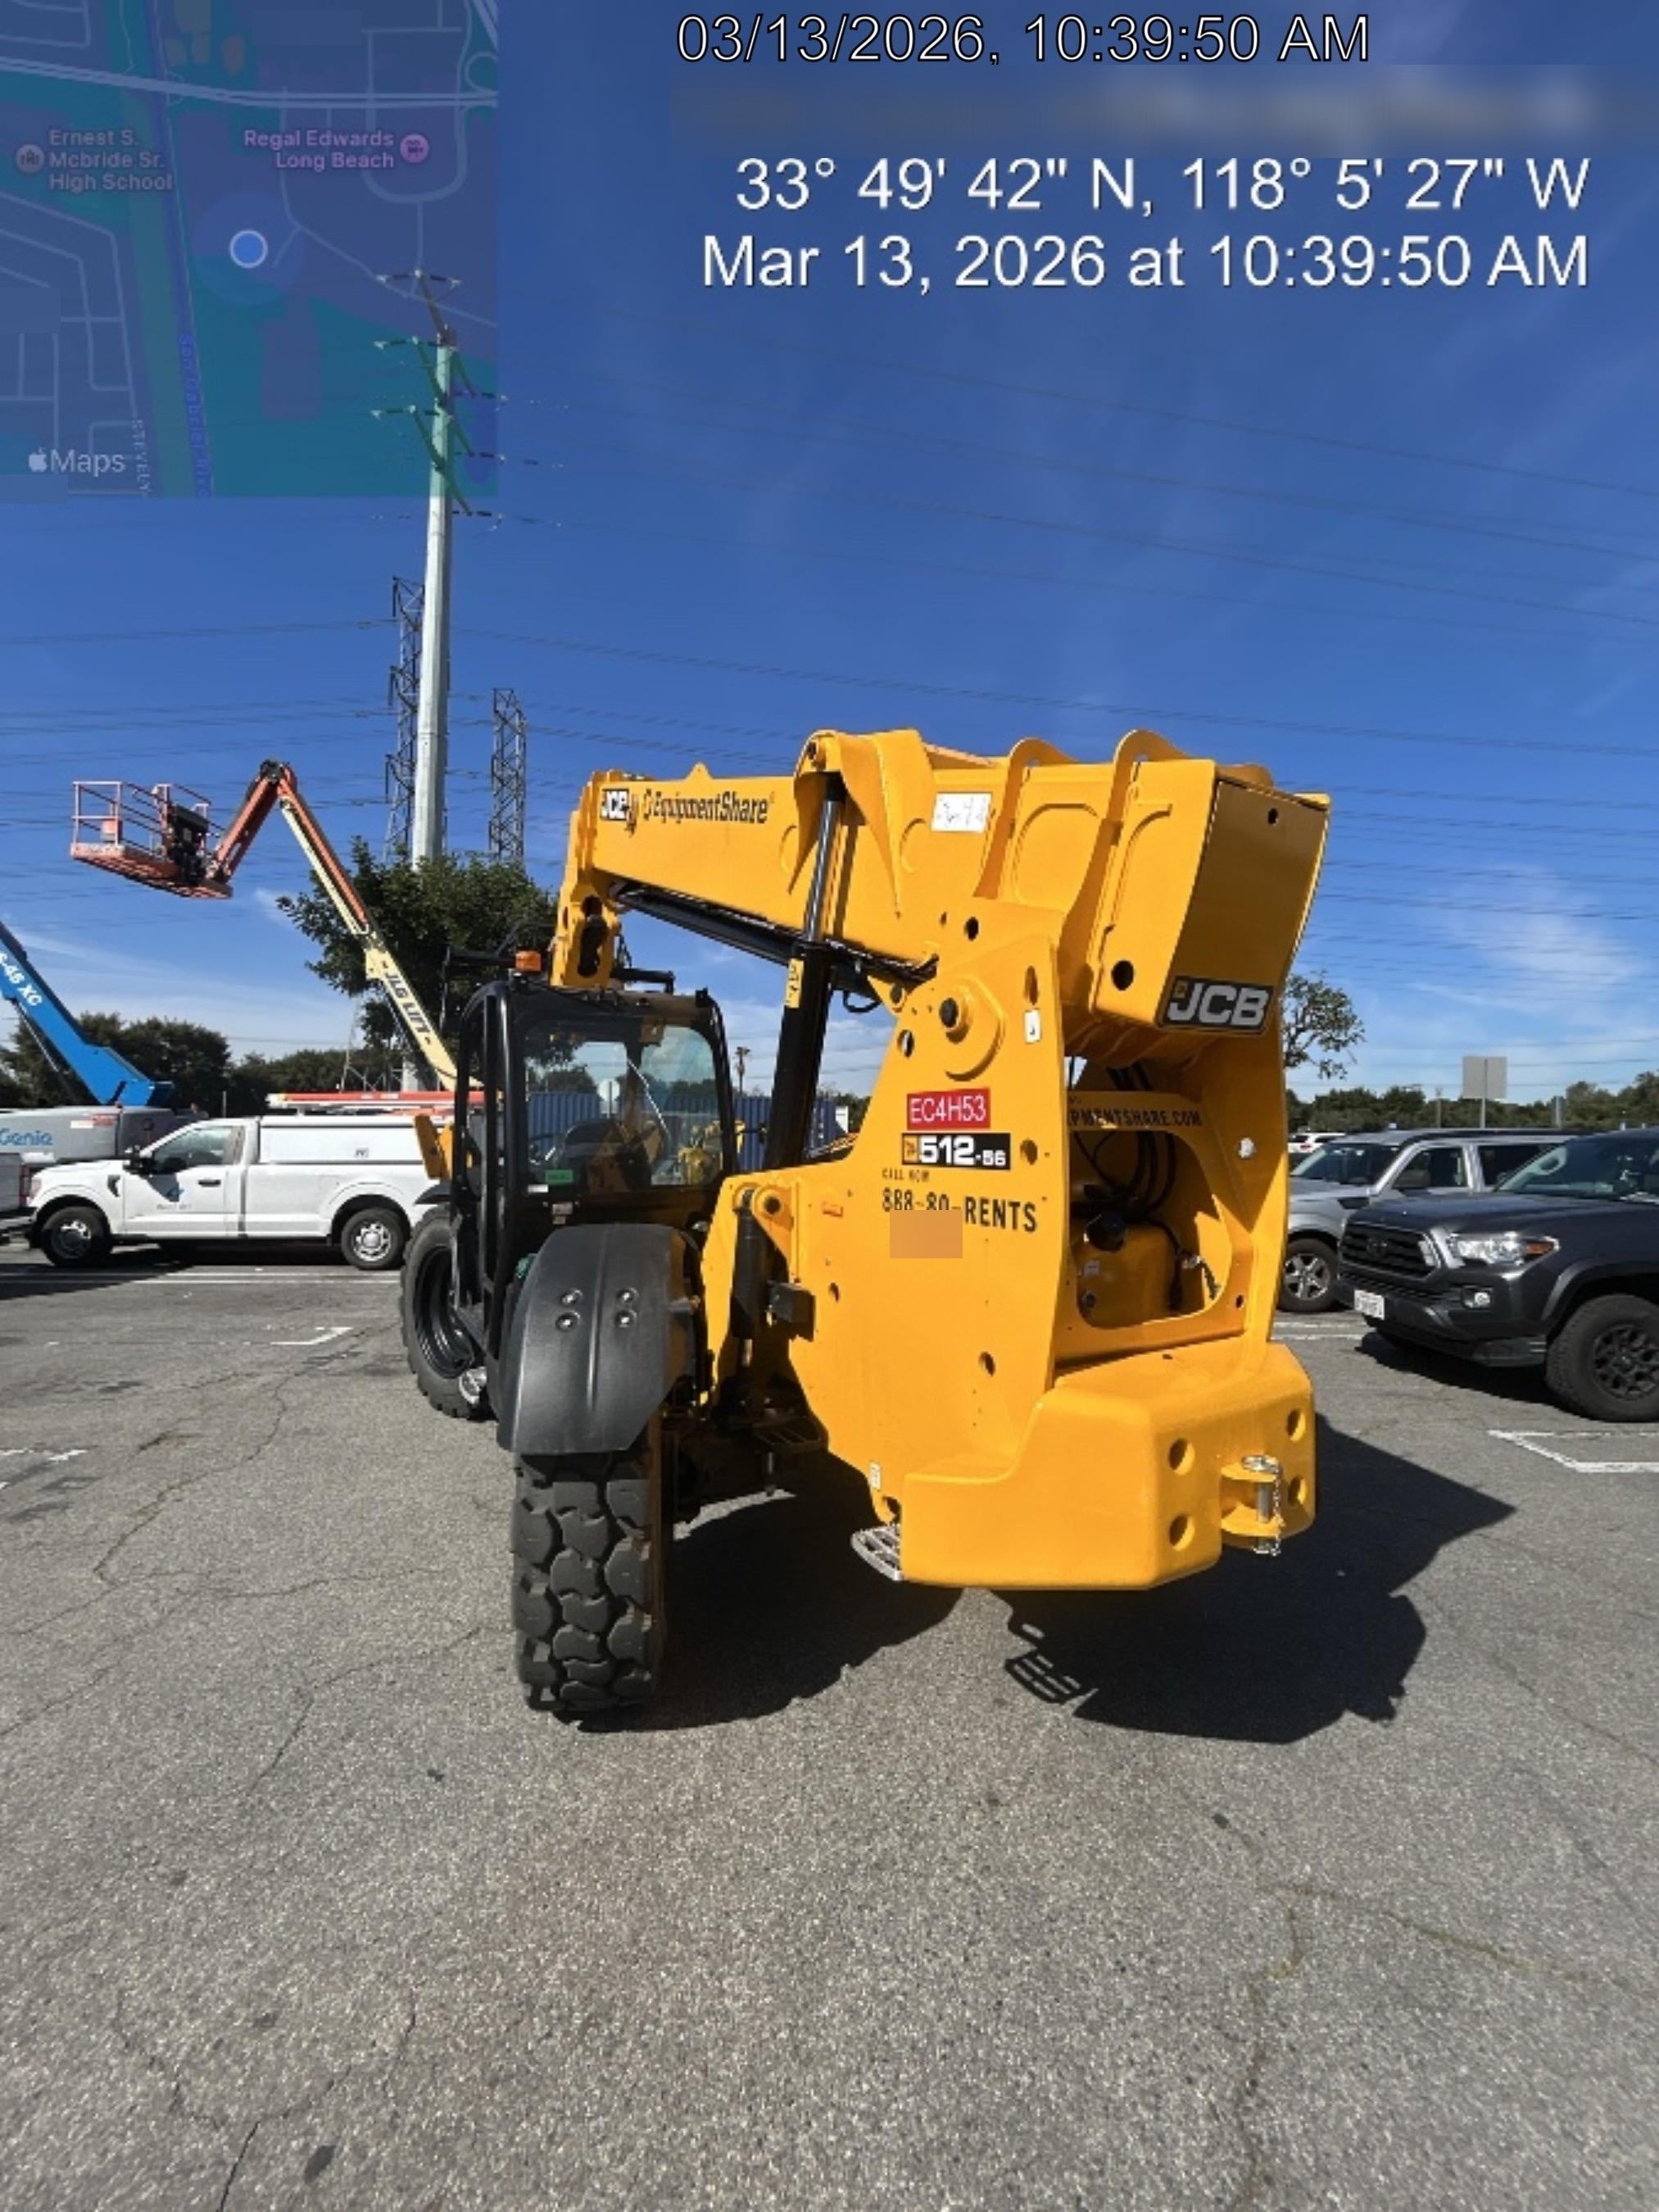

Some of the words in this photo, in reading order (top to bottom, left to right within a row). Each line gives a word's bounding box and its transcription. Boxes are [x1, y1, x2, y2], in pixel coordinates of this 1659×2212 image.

[654, 790, 768, 824] EquipmentShare
[1167, 982, 1269, 1027] JCB
[910, 1094, 986, 1124] EC4H53
[1067, 1108, 1203, 1126] PMENTSHARE.COM
